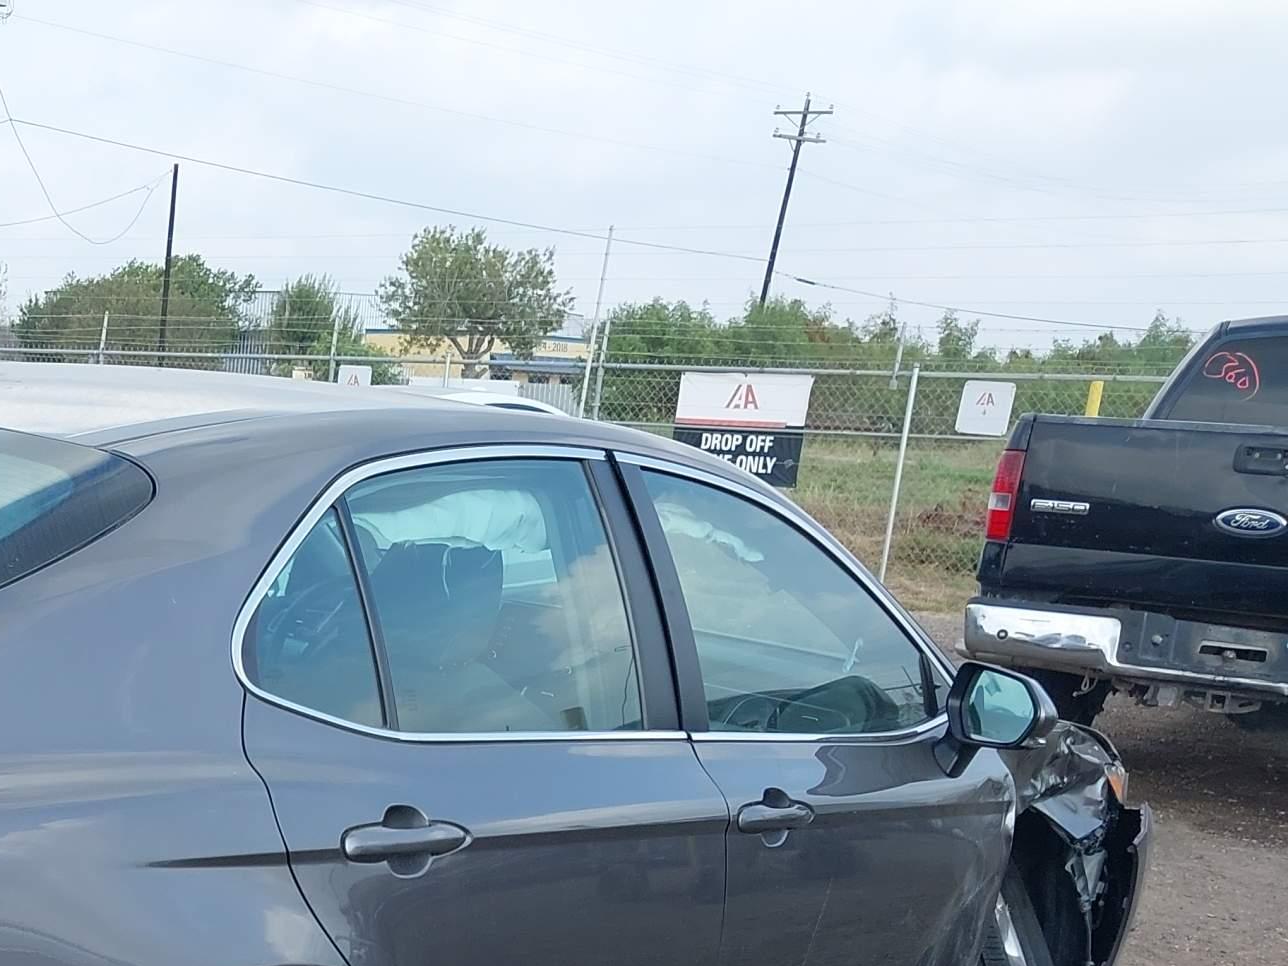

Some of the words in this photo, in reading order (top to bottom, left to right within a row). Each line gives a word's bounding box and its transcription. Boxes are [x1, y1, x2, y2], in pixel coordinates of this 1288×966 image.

[700, 432, 743, 452] DROP
[745, 435, 774, 453] OFF
[735, 455, 777, 475] ONLY
[1230, 513, 1270, 529] Ford
